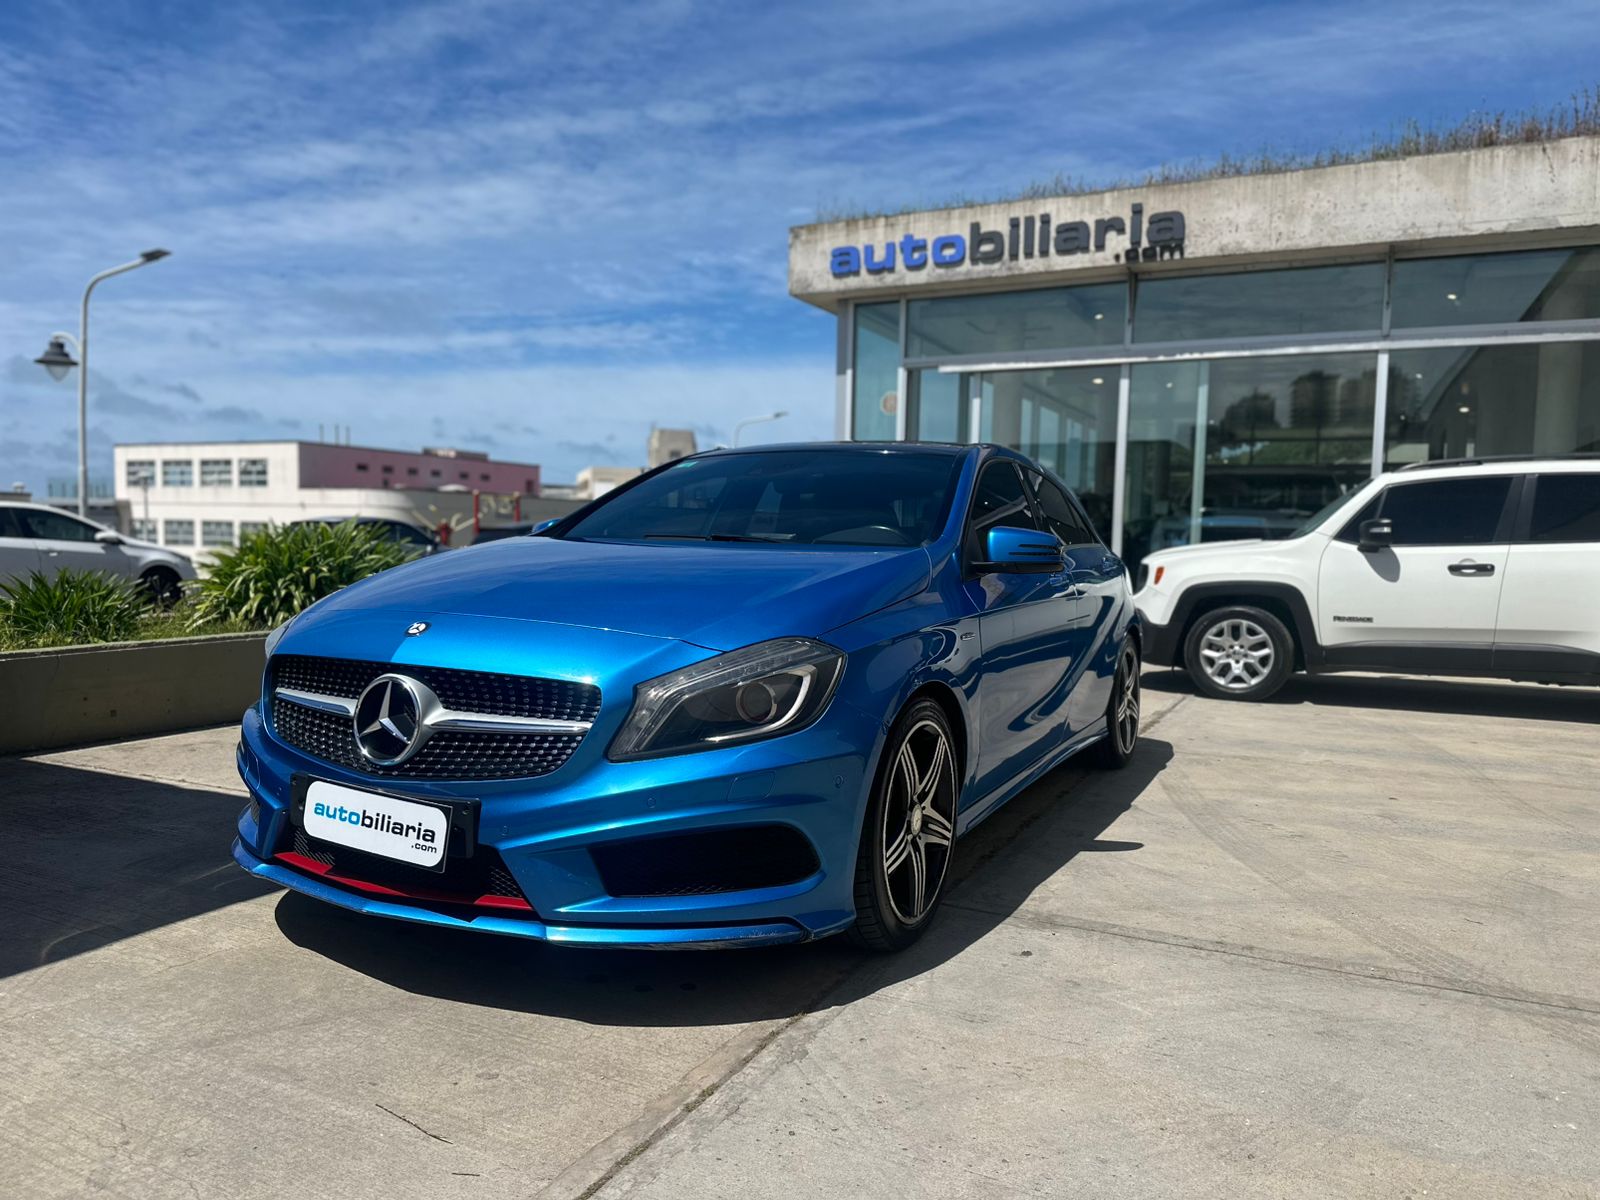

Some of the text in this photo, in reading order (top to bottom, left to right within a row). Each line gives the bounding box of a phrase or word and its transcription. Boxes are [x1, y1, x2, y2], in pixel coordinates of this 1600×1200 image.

[830, 203, 1186, 278] autobiliaria
[1114, 244, 1185, 263] .com
[314, 802, 436, 843] autobiliaria
[411, 842, 437, 854] .com
